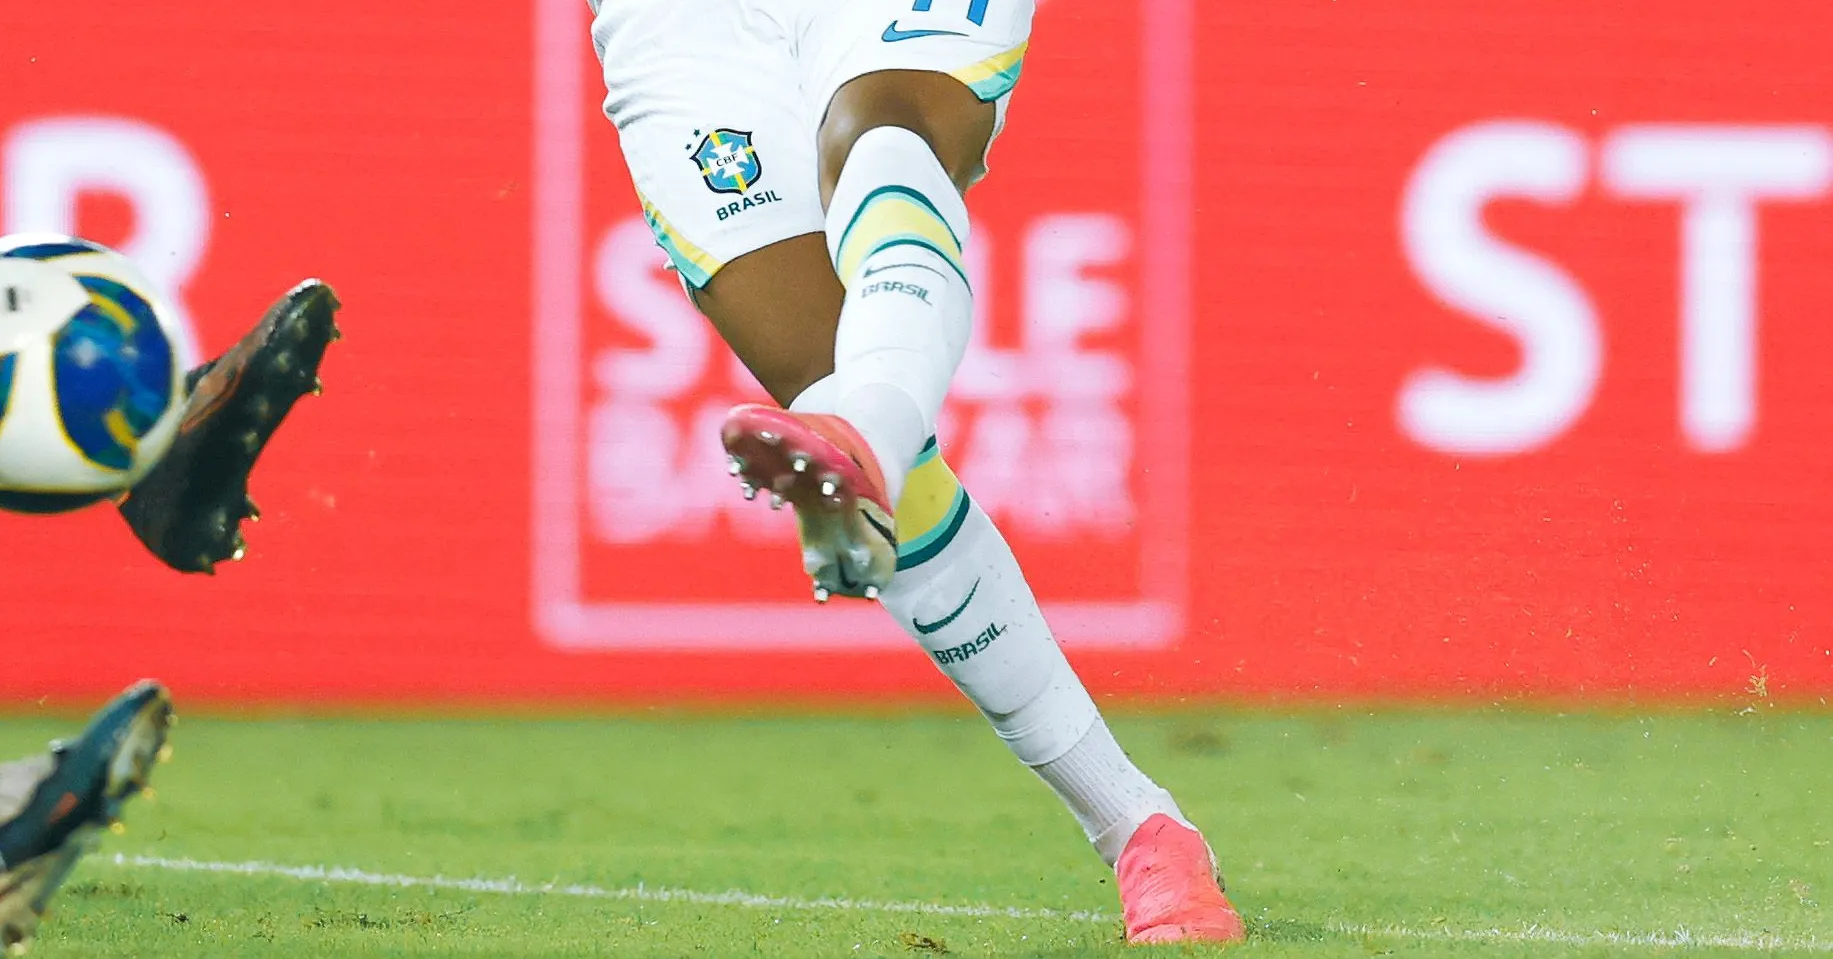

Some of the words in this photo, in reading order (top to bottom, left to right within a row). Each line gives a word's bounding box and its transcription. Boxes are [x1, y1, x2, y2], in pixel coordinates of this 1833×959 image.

[716, 153, 739, 167] CBF
[716, 190, 783, 221] BRASIL
[861, 281, 934, 307] BRASIL
[1396, 118, 1833, 455] ST
[933, 622, 1008, 665] BRASIL
